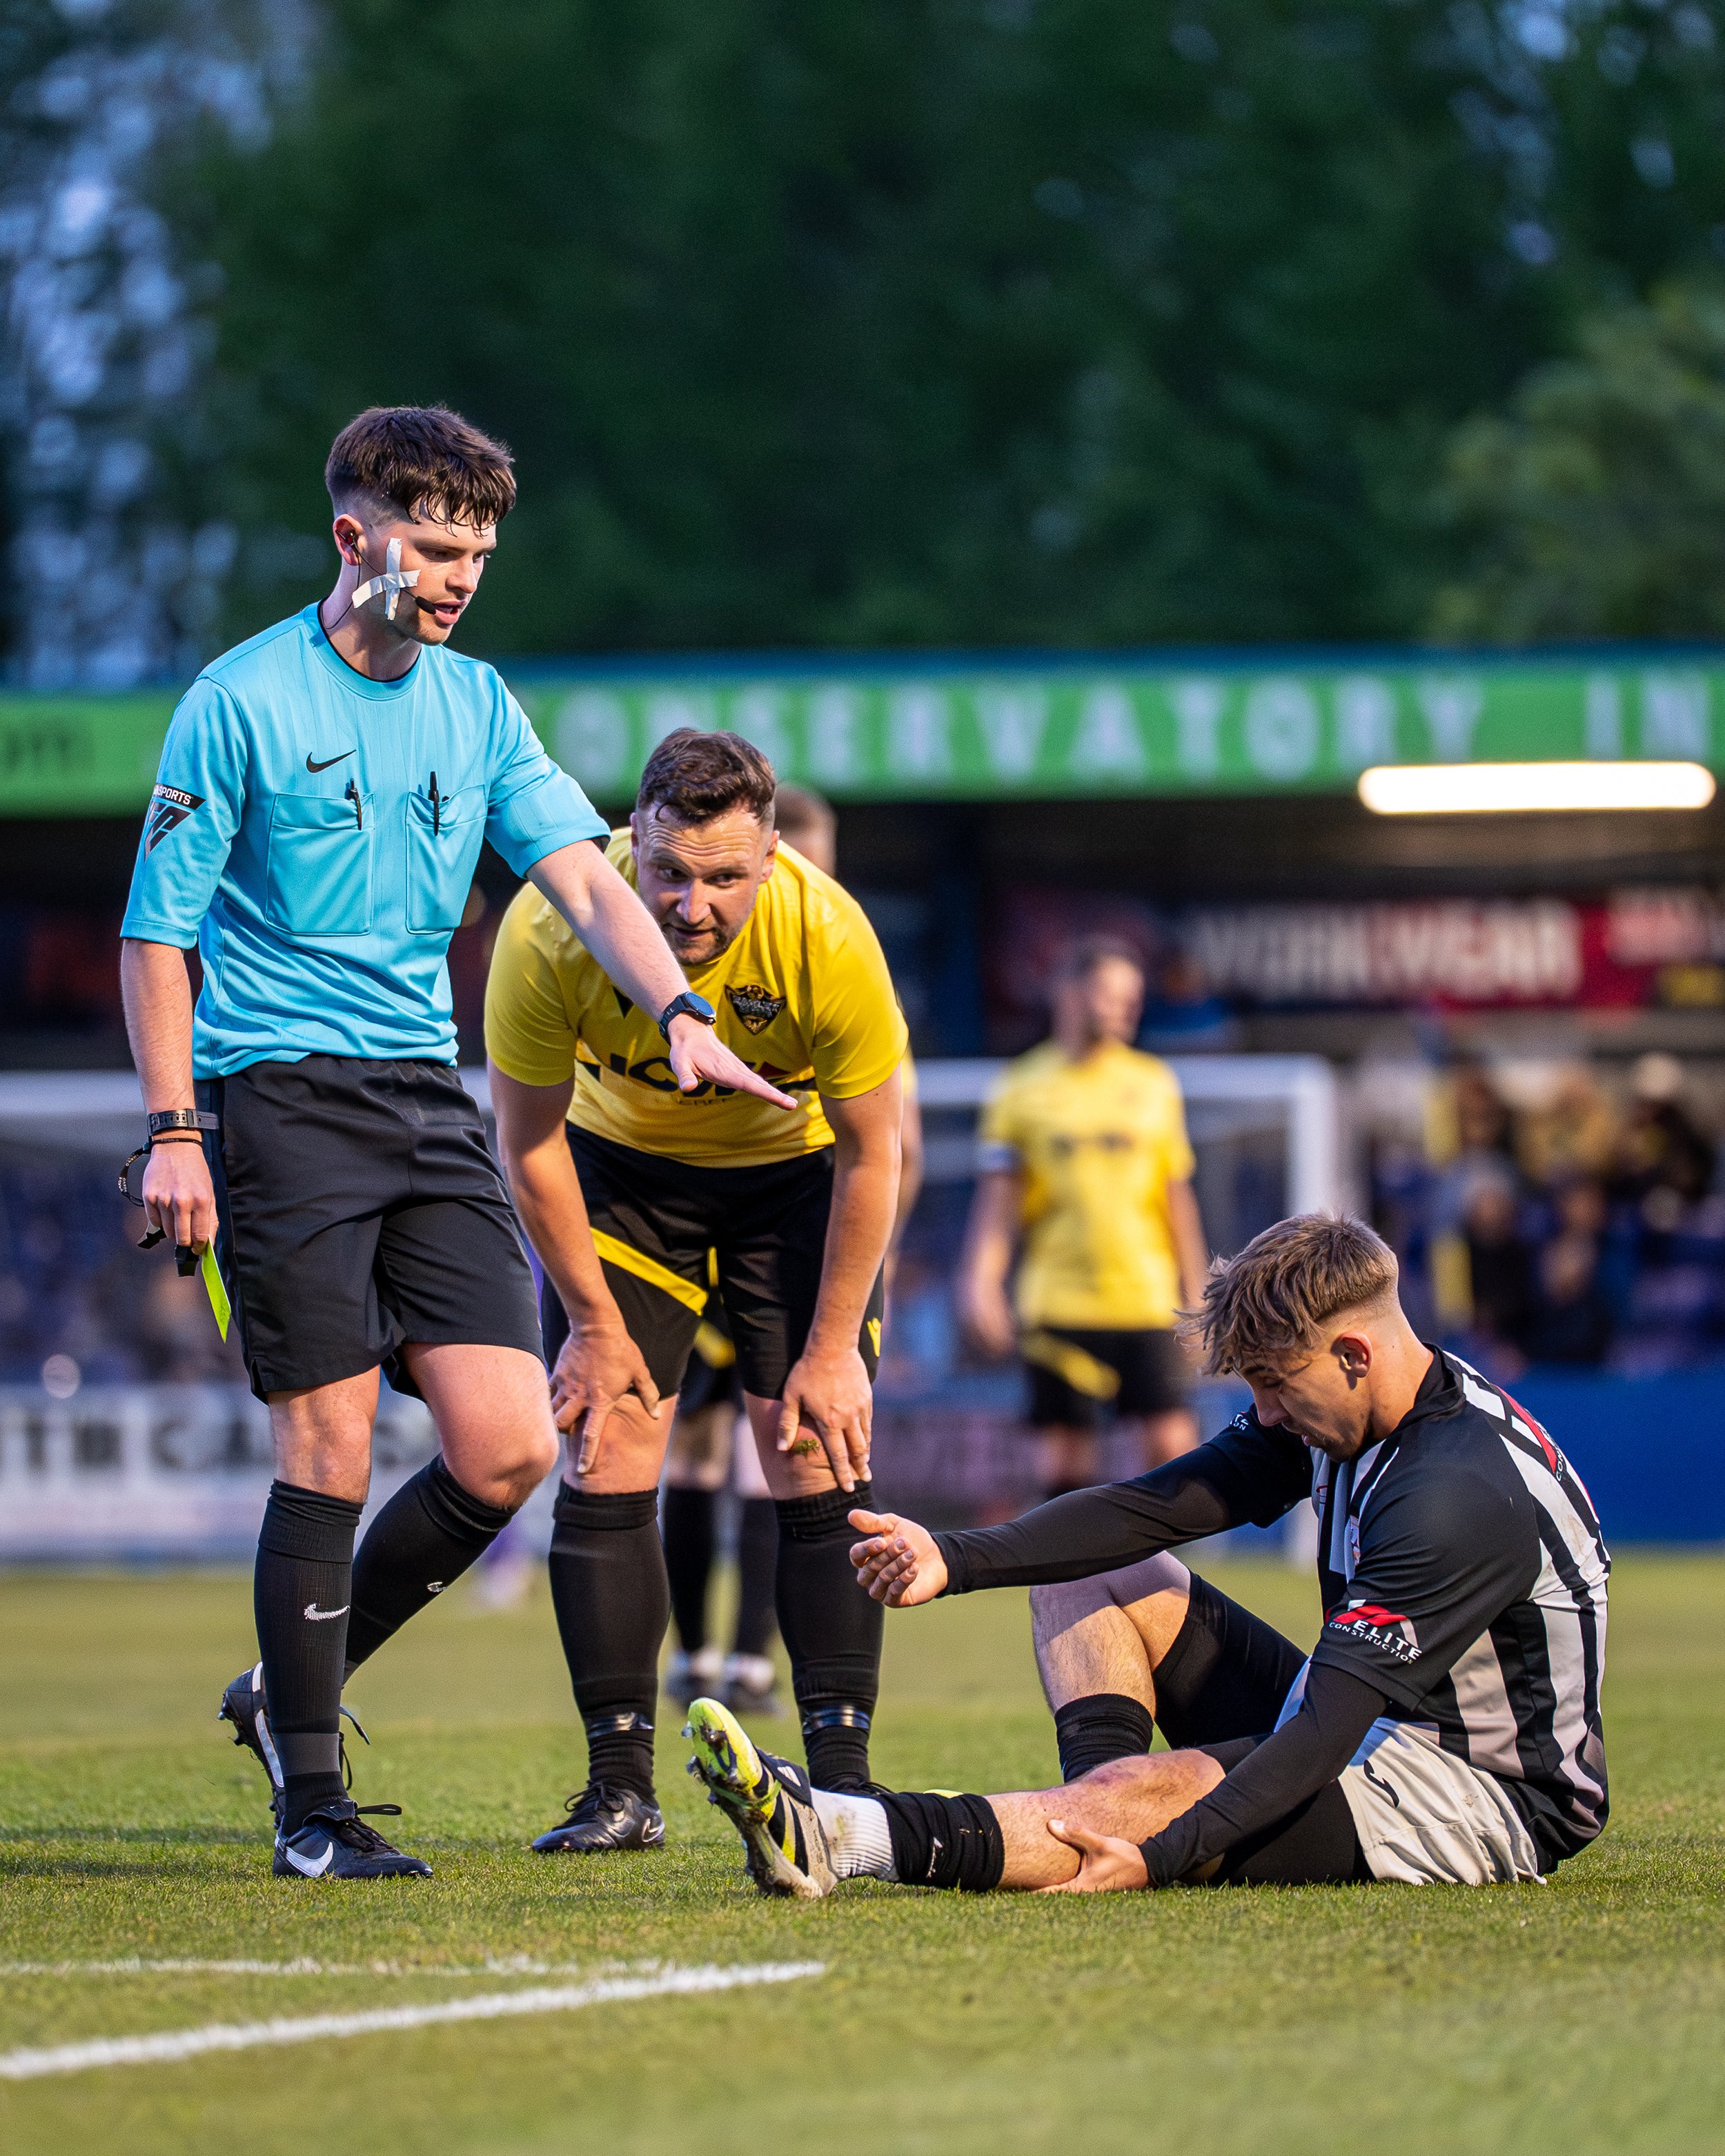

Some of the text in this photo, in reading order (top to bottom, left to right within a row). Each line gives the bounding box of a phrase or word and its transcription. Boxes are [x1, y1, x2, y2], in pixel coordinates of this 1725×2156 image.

[516, 672, 1483, 788] ONSERVATORY
[1329, 1622, 1414, 1664] CONSTRUCTION
[1353, 1619, 1422, 1660] ELITE
